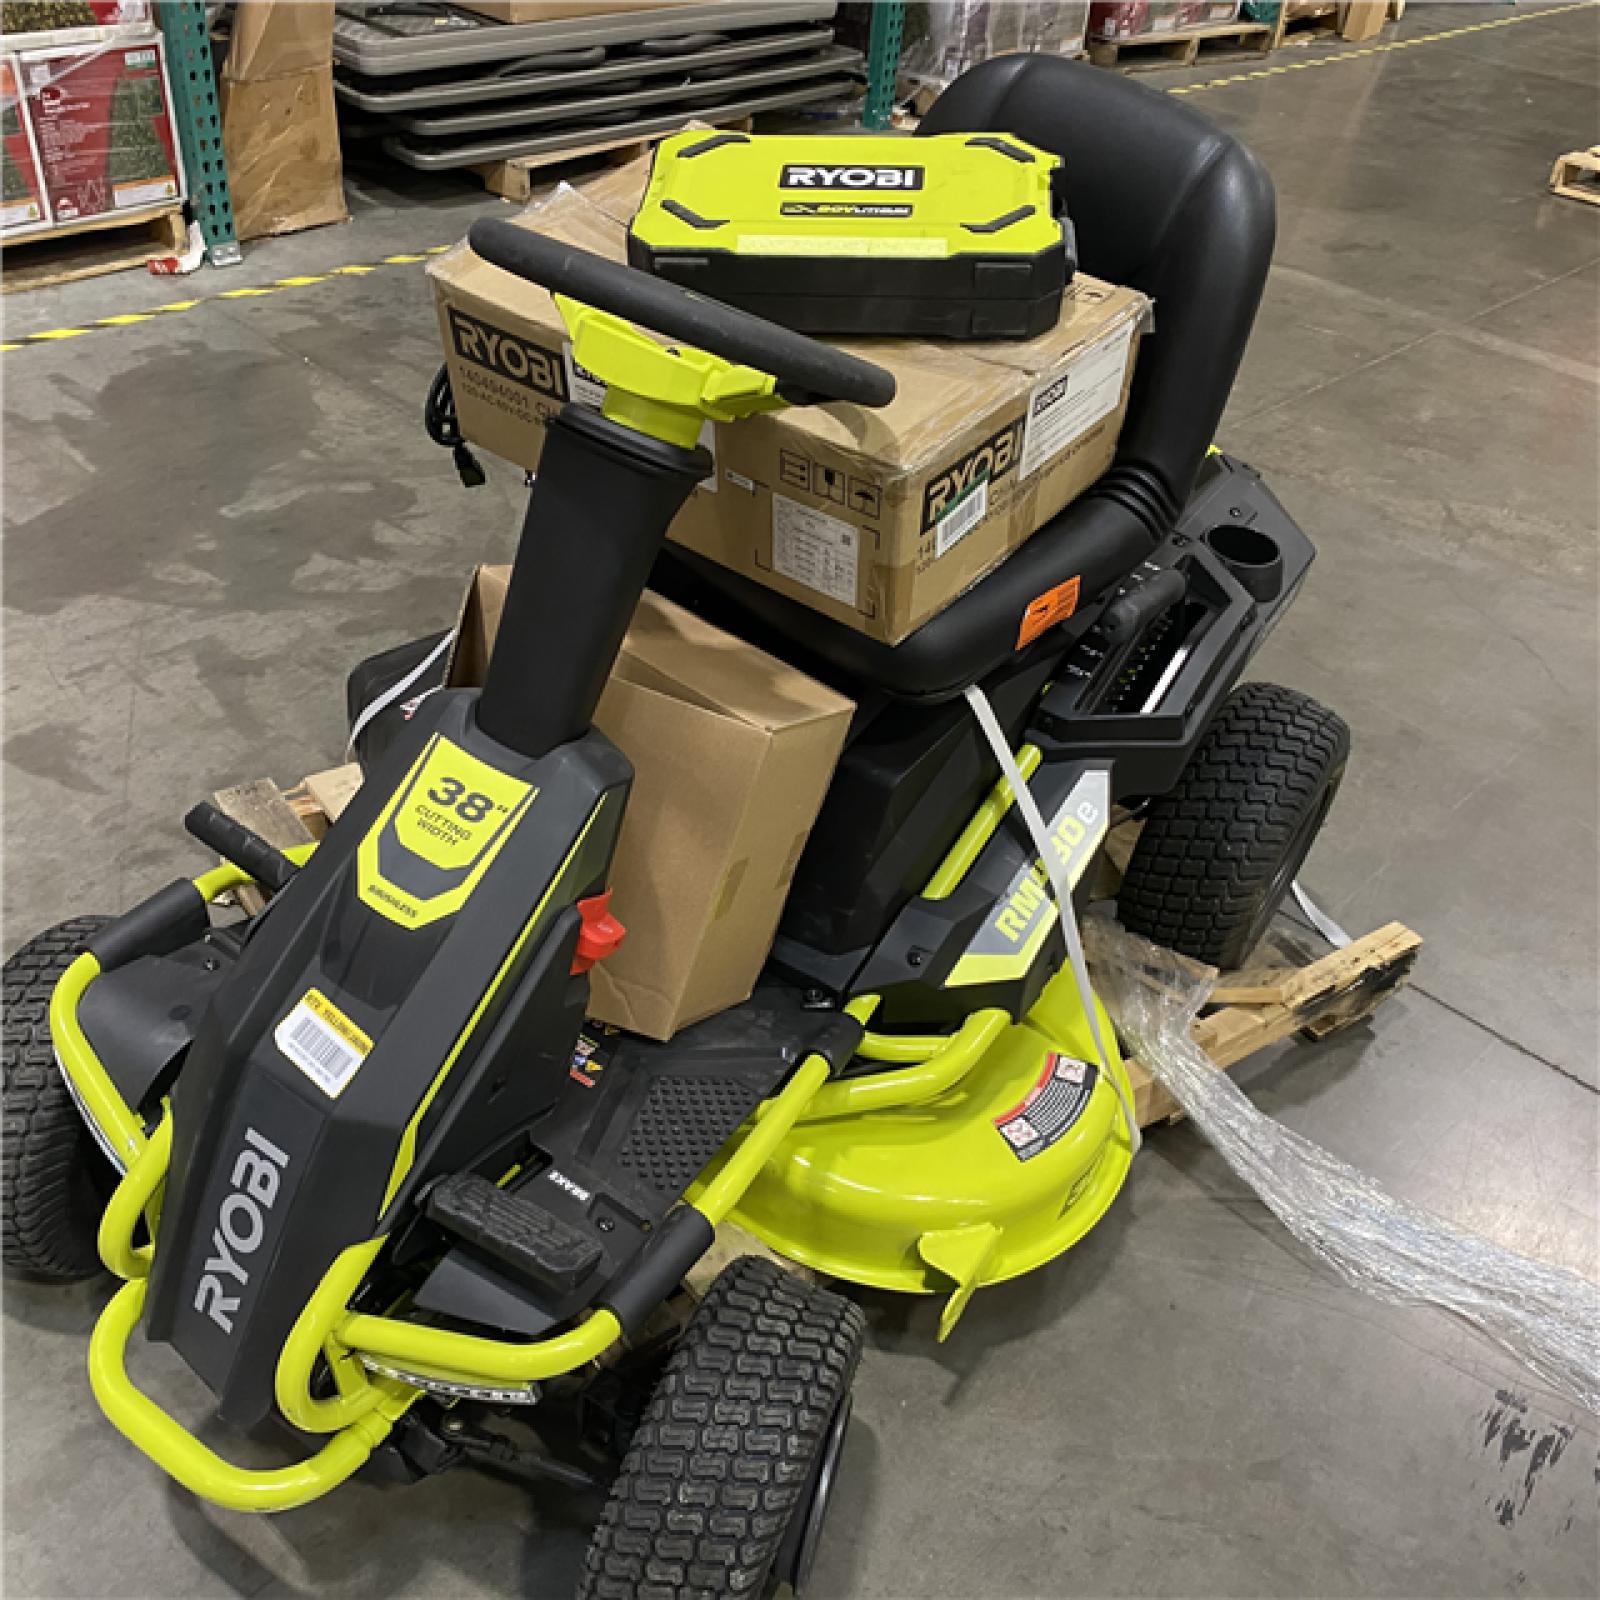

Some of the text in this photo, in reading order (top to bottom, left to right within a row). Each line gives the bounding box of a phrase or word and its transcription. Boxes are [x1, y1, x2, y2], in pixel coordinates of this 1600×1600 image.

[787, 167, 915, 188] RYOBI
[454, 316, 564, 396] RYOBI
[415, 804, 473, 840] CUTTING
[193, 1126, 290, 1334] RYOBI
